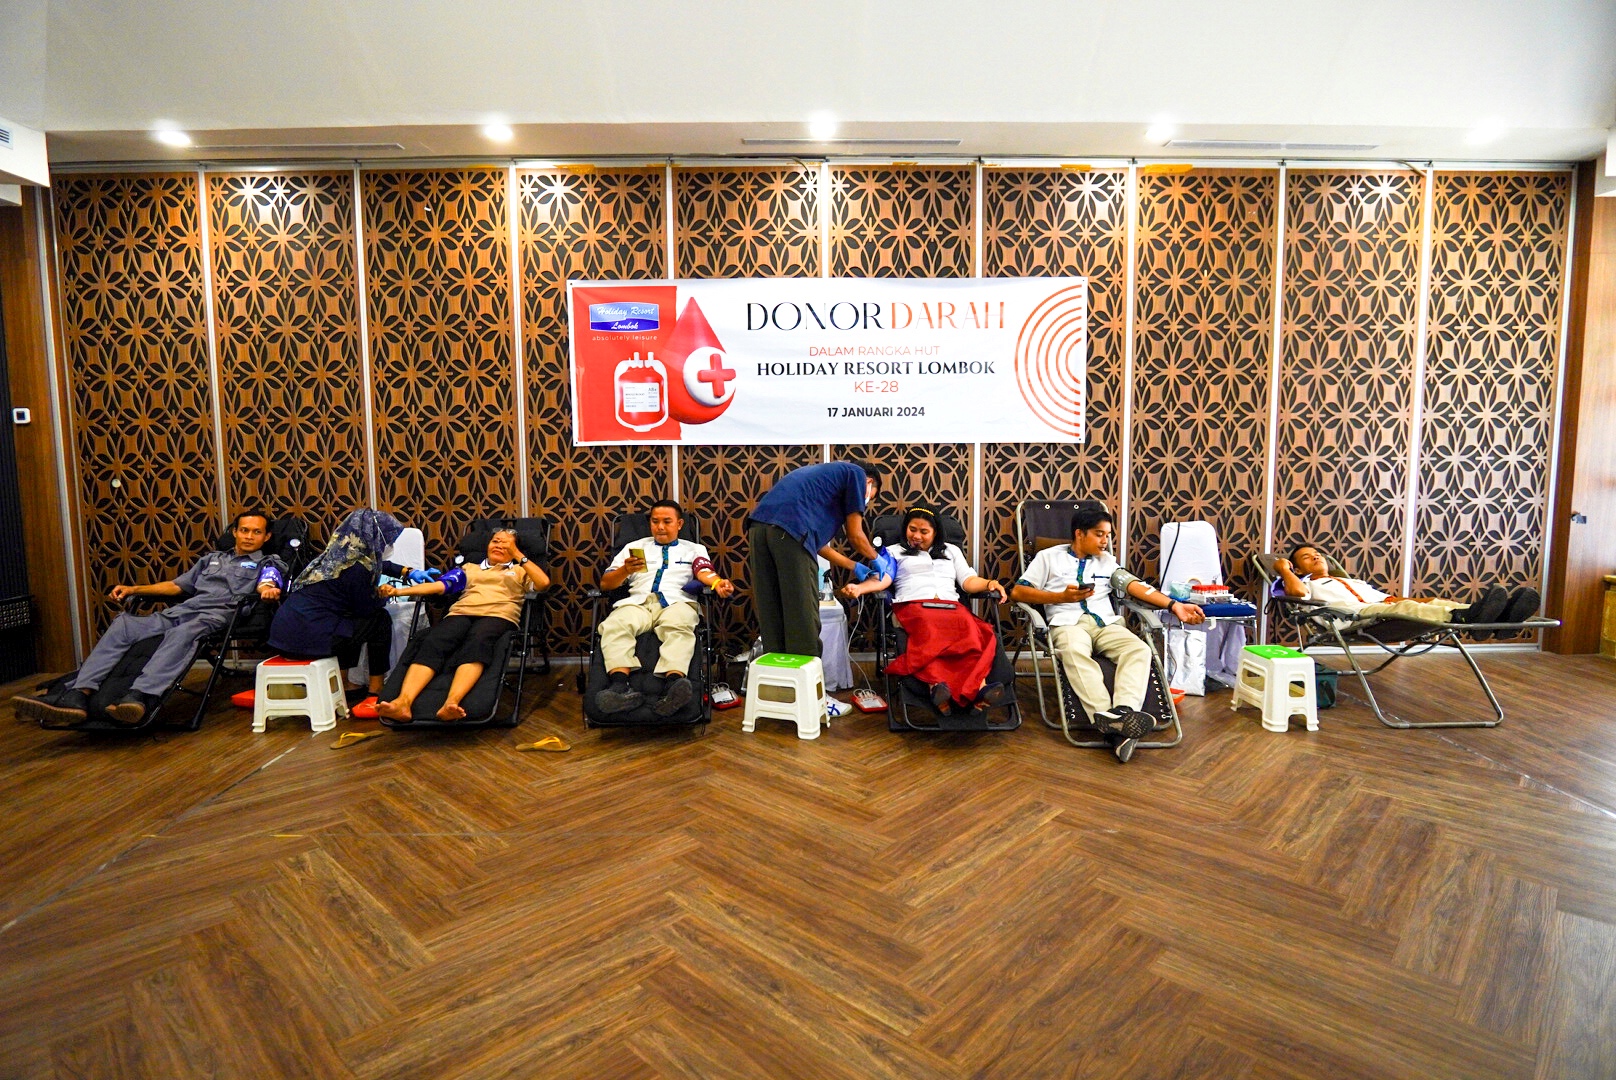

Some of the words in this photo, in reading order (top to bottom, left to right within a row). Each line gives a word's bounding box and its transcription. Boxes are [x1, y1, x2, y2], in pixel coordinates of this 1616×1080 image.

[597, 306, 627, 317] Holiday
[631, 306, 655, 315] Resort
[747, 301, 886, 331] DONOR
[891, 301, 1005, 330] DARAH
[611, 321, 639, 330] Lombok
[809, 346, 854, 357] DALAM
[858, 346, 912, 356] RANGKA
[915, 345, 940, 356] HUT
[757, 362, 839, 376] HOLIDAY
[844, 361, 914, 376] RESORT
[918, 361, 996, 375] LOMBOK
[854, 380, 899, 393] KE-28
[827, 407, 838, 417] 17
[841, 407, 893, 417] JANUARI
[896, 406, 925, 417] 2024
